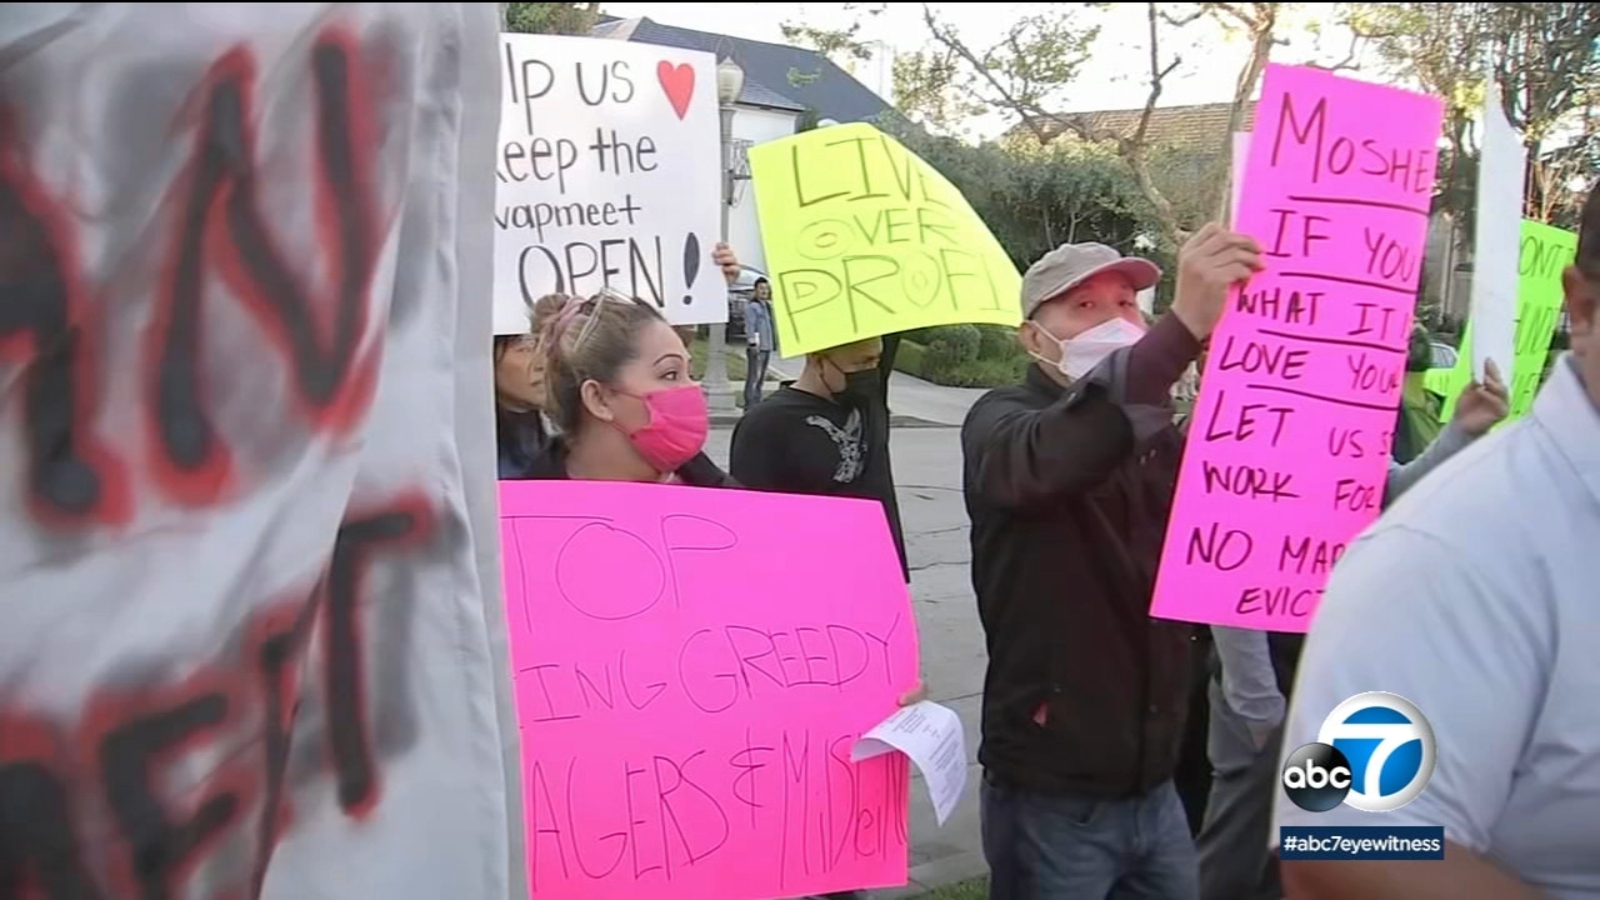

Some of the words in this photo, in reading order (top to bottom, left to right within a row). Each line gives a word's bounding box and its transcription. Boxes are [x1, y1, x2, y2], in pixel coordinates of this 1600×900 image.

[506, 42, 555, 135] lp
[576, 60, 634, 106] us
[496, 137, 578, 195] eep
[589, 127, 658, 175] the
[1271, 91, 1431, 193] MOSHE
[796, 206, 960, 261] OVER
[1265, 208, 1332, 258] IF
[1364, 227, 1416, 283] YOU
[778, 247, 1017, 344] PROFI
[1237, 285, 1325, 326] WHAT
[1219, 336, 1310, 380] LOVE
[1204, 390, 1294, 448] LET
[1328, 427, 1364, 458] US
[1202, 460, 1300, 502] WORK
[499, 514, 739, 634] TOP
[1186, 522, 1253, 571] NO
[1235, 586, 1326, 617] EVIC
[514, 650, 667, 728] ING
[678, 612, 901, 713] GREEDY
[531, 749, 730, 893] AGERS
